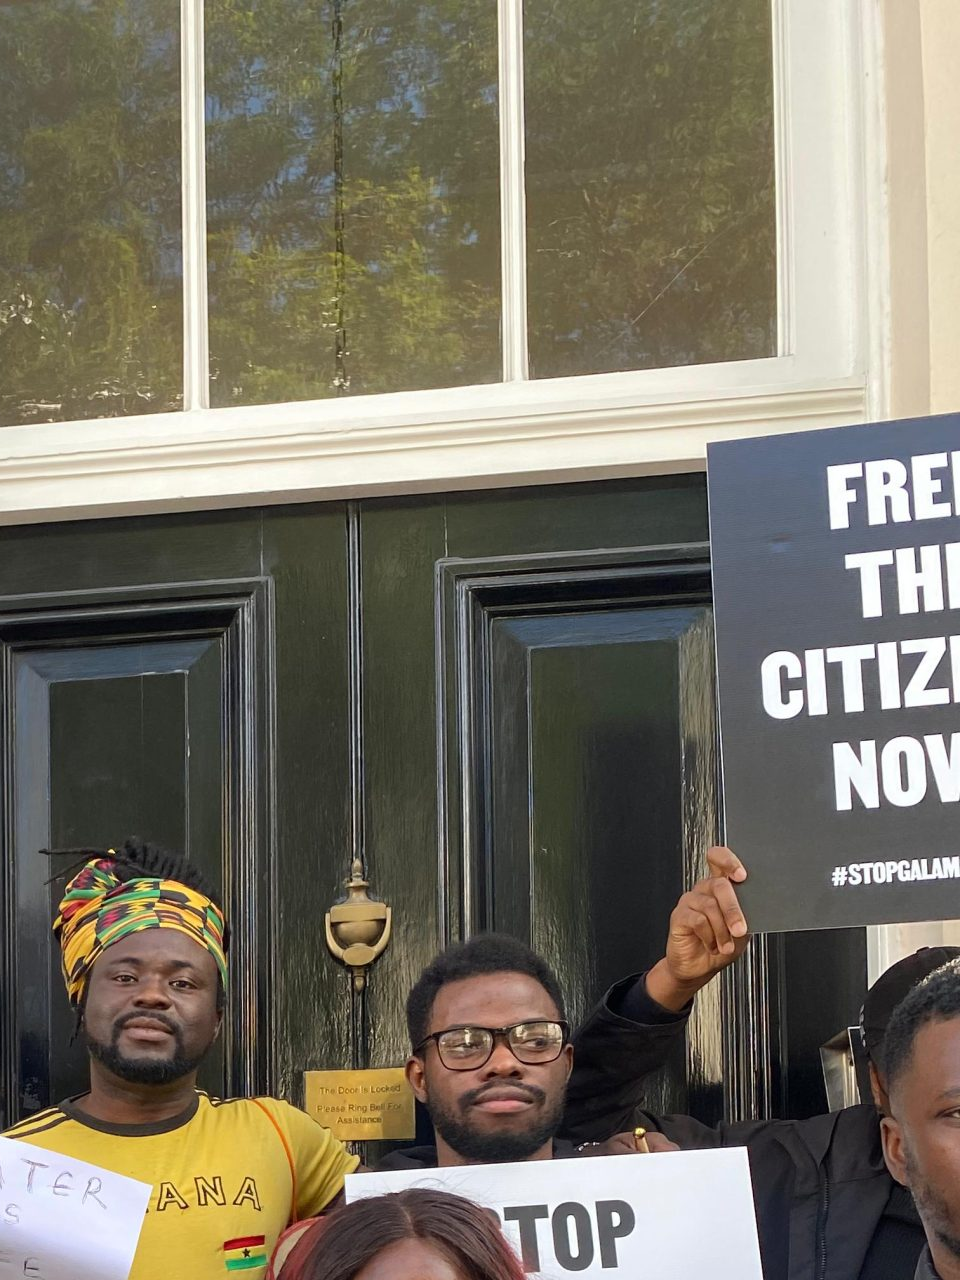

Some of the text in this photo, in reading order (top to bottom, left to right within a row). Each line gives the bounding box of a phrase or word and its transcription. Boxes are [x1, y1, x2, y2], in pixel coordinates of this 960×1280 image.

[827, 450, 960, 530] FRE
[320, 1084, 401, 1095] The Door Is Locked
[317, 1102, 402, 1114] Please Ring Bell For
[337, 1116, 382, 1125] Assistance
[145, 1175, 262, 1213] ANA
[483, 1199, 636, 1274] TOP
